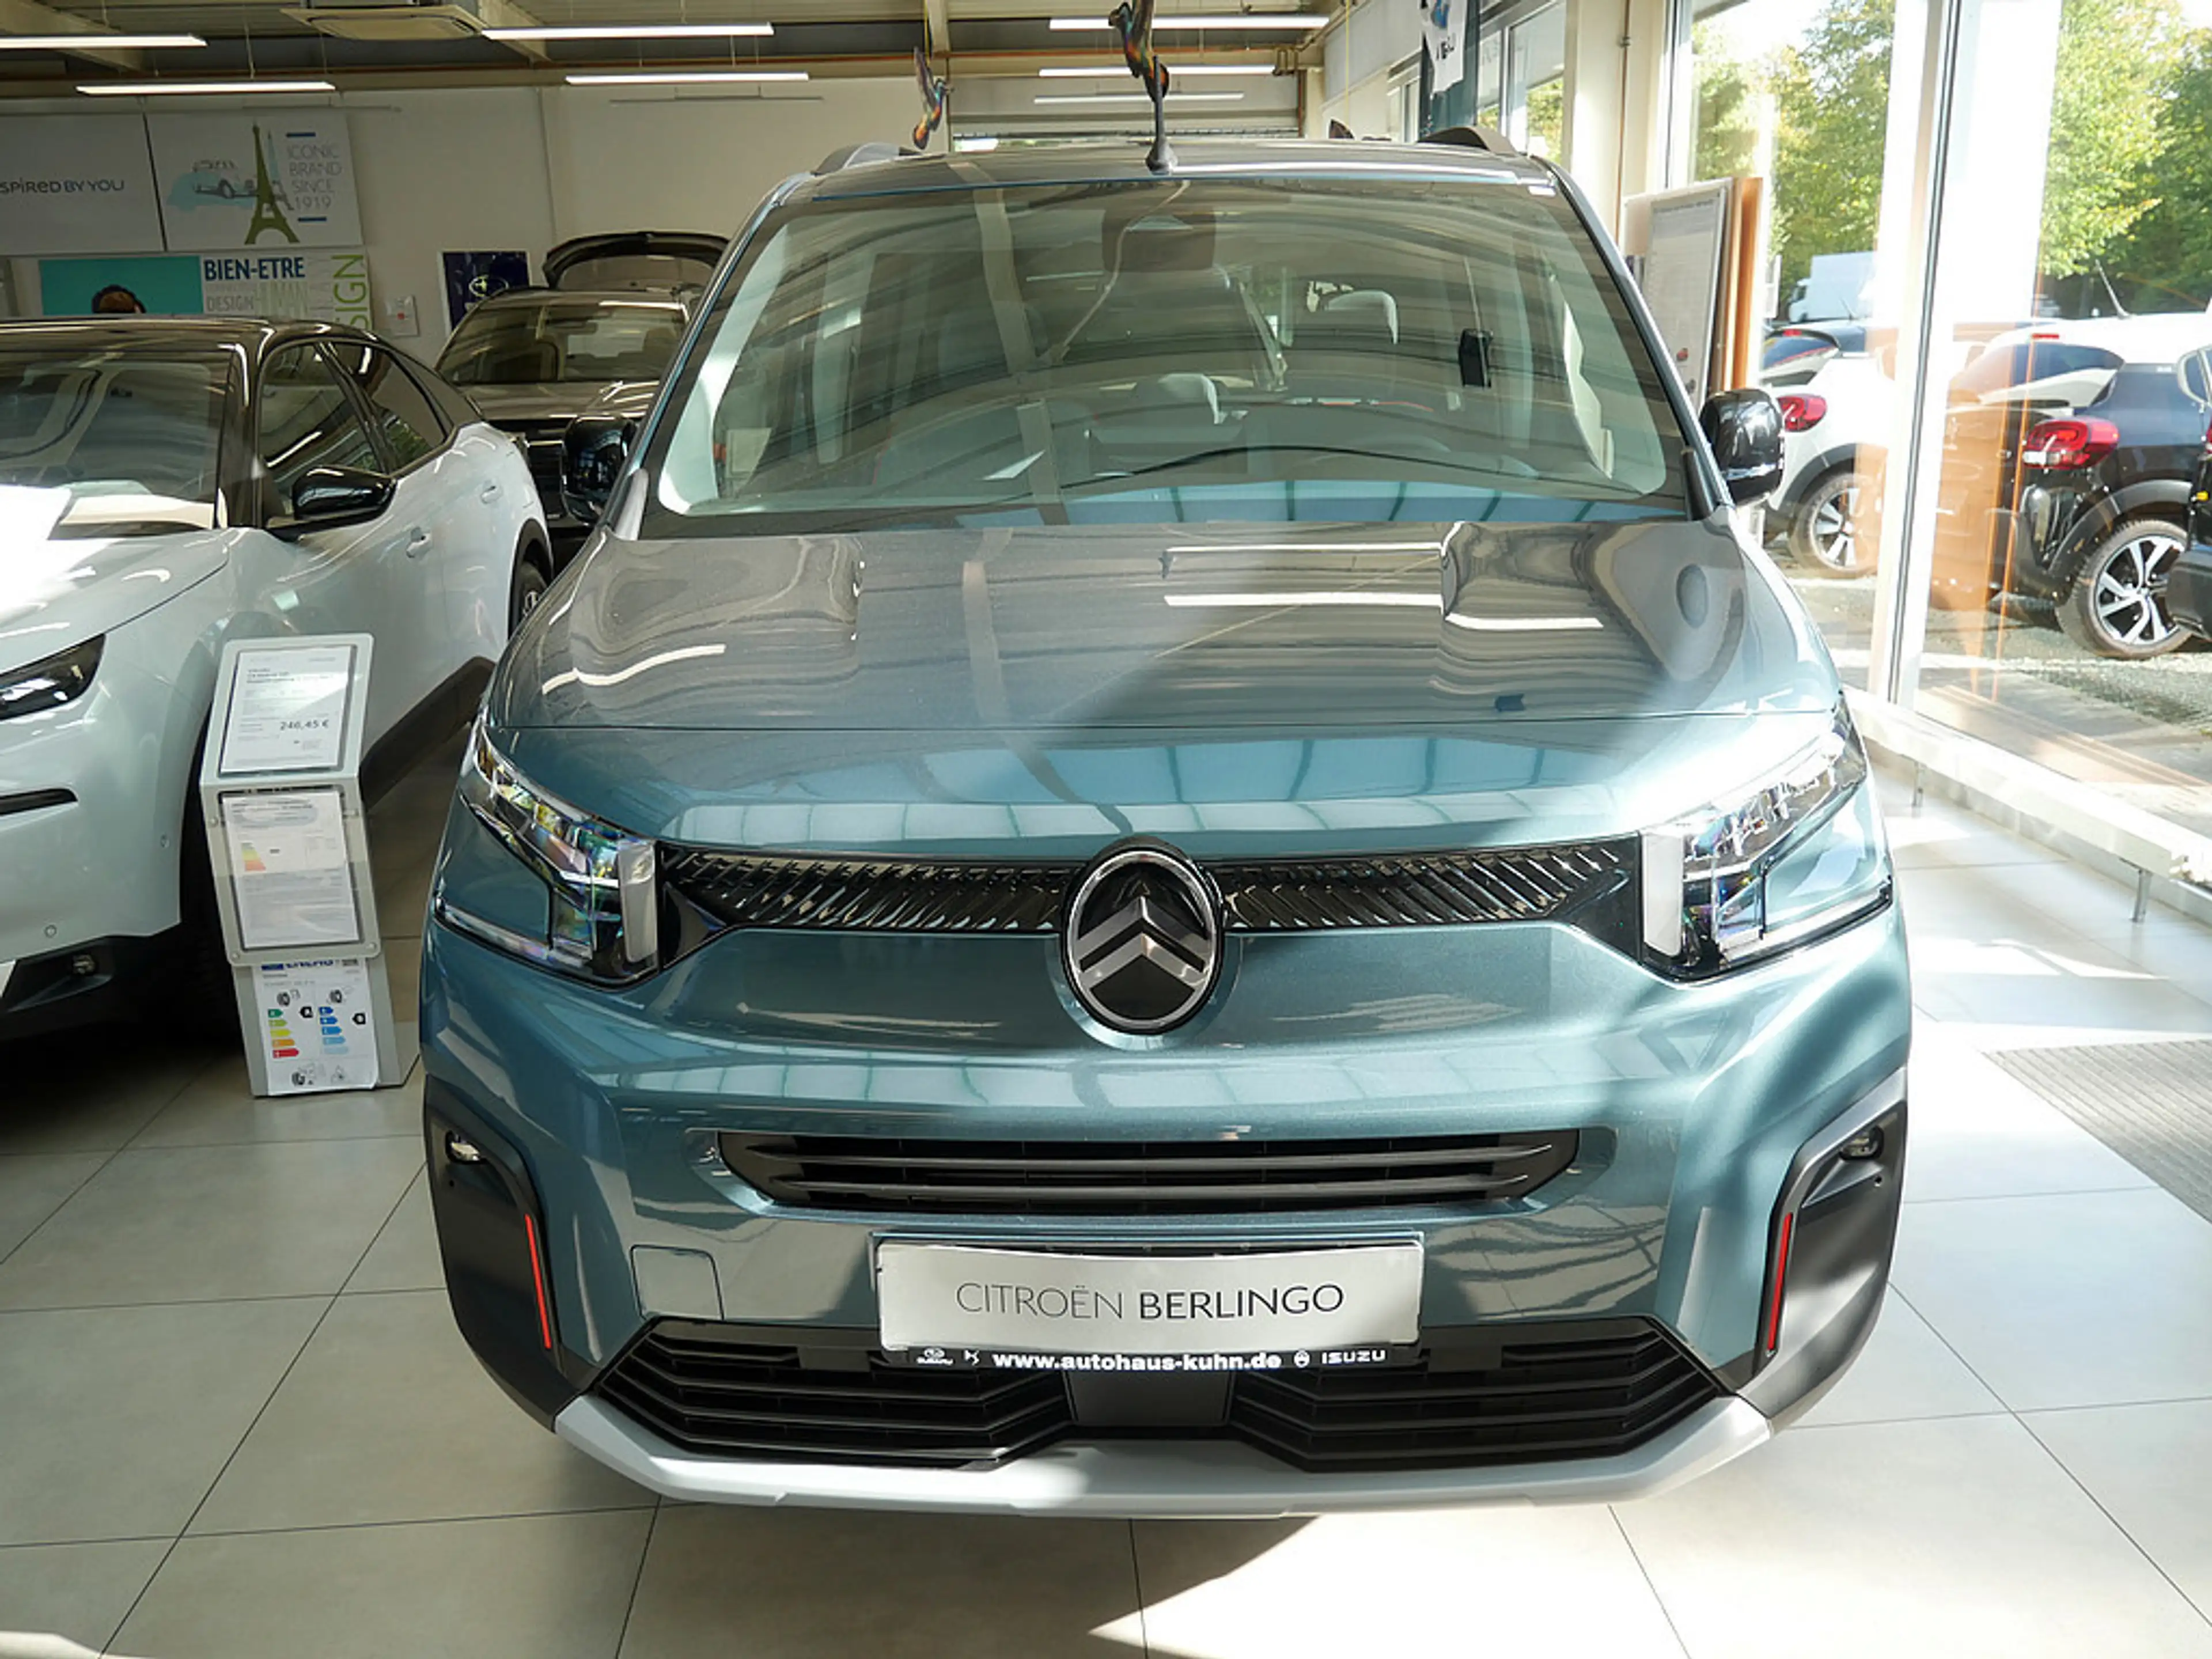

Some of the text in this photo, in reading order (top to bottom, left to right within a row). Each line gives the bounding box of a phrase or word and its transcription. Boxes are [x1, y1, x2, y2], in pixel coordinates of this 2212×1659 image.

[289, 162, 342, 176] BRAND
[63, 179, 85, 193] BY
[87, 179, 124, 192] YOU
[291, 178, 335, 193] SINCE
[296, 195, 331, 209] 1919
[204, 257, 306, 281] BIEN-ETRE
[207, 295, 254, 312] DESIGN
[956, 1282, 1344, 1320] CITROËN BERLINGO
[993, 1350, 1385, 1372] www.autohaus-kuhn.de ISUZU
